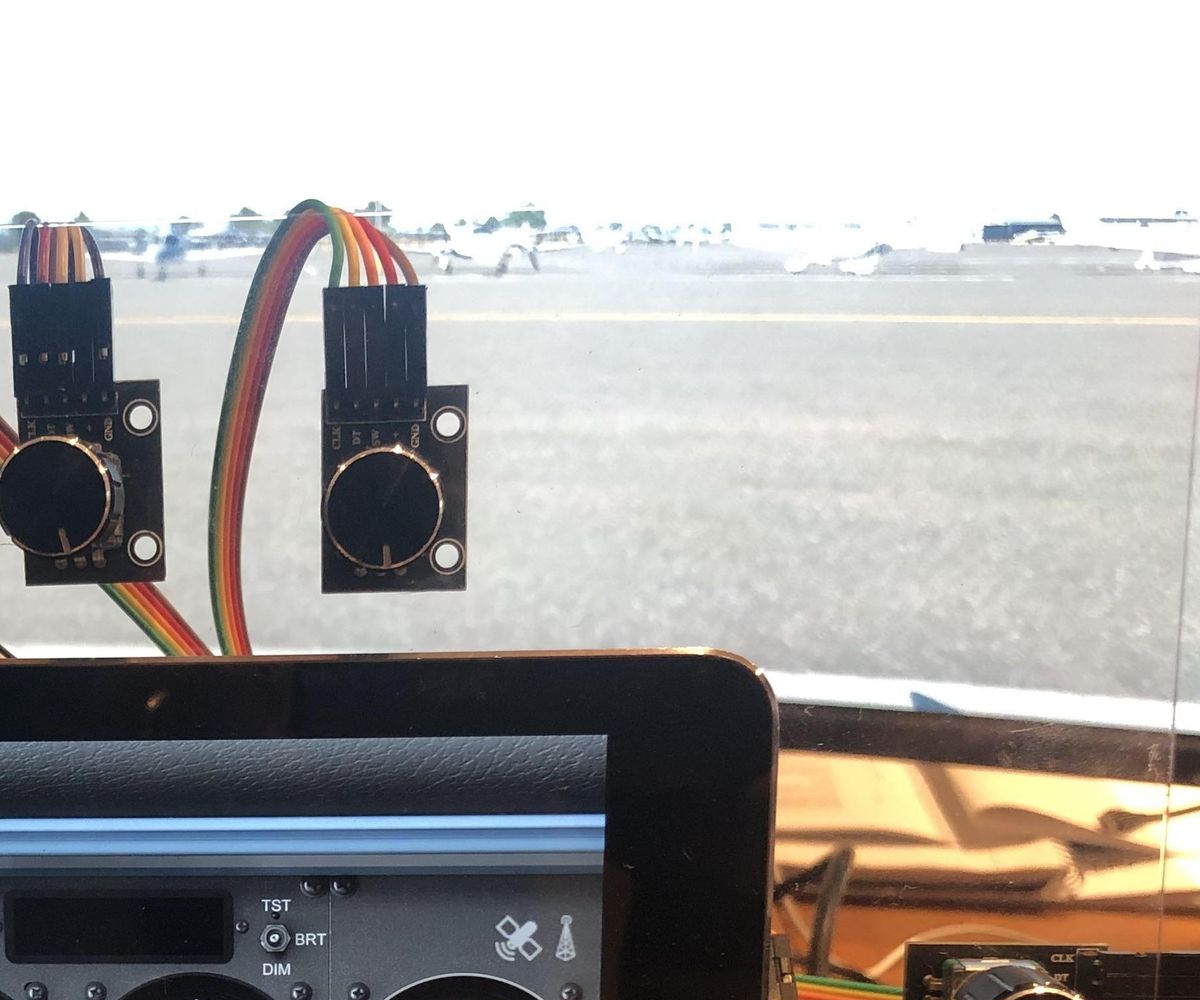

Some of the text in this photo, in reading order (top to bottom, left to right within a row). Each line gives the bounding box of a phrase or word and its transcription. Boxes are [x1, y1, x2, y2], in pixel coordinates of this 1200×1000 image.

[104, 417, 114, 441] GND
[411, 424, 420, 448] GND
[261, 899, 291, 912] TST
[295, 933, 327, 945] BRT
[1050, 953, 1075, 963] CLK
[262, 963, 291, 975] DIM
